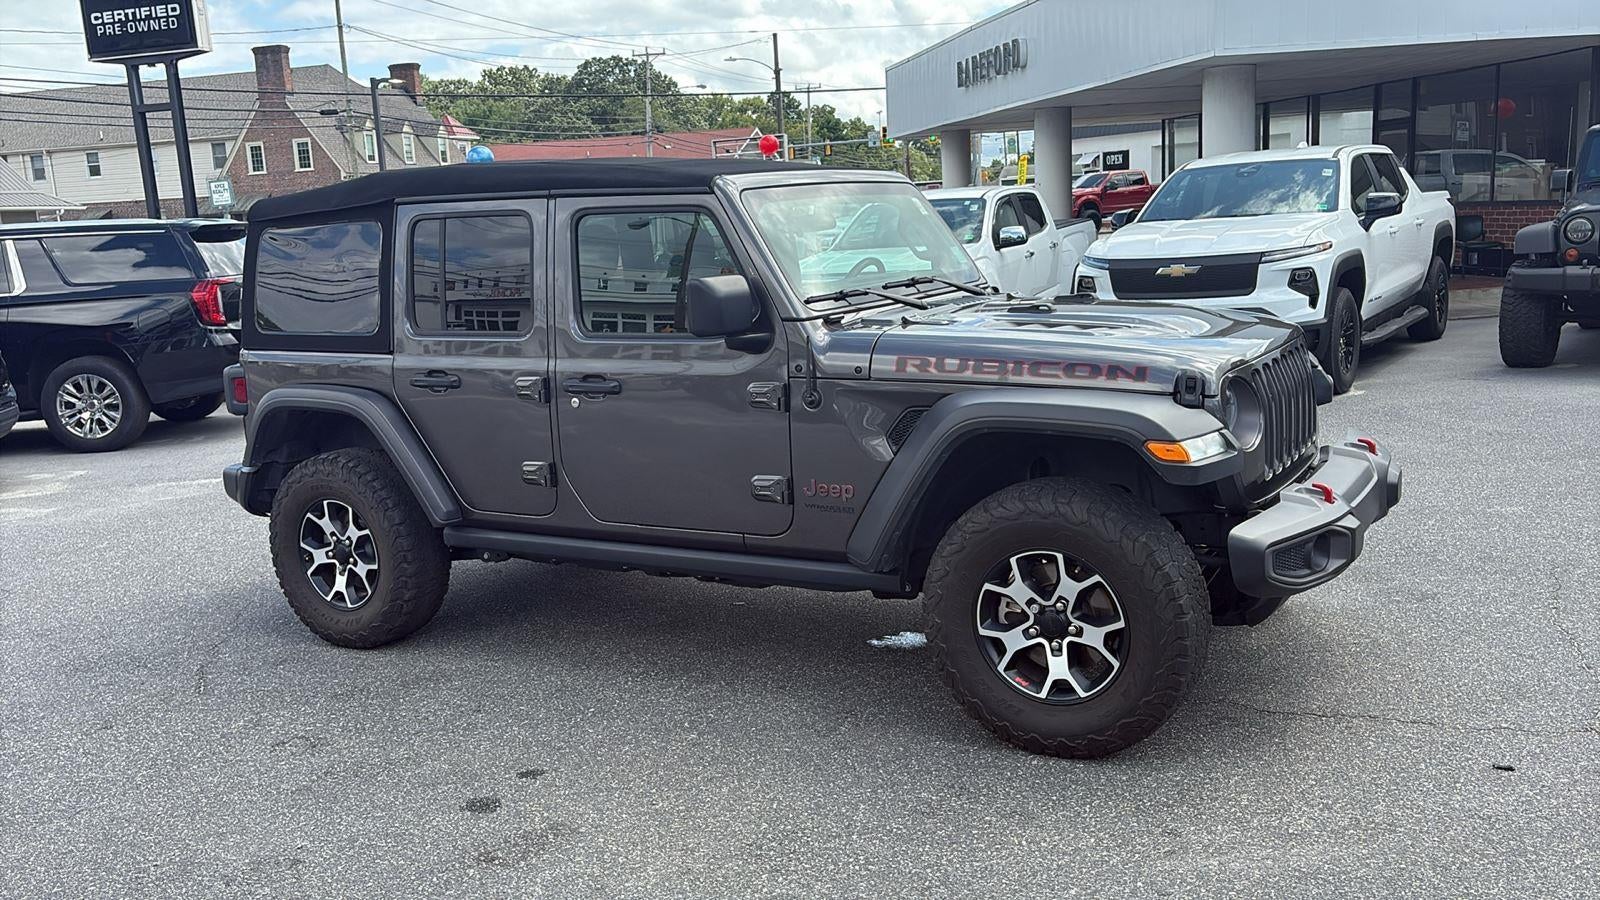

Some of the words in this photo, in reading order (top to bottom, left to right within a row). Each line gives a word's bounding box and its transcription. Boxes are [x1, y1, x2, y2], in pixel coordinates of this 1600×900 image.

[90, 3, 180, 24] CERTIFIED
[96, 17, 178, 36] PRE-OWNED
[956, 38, 1028, 88] BAREFORD
[1106, 154, 1123, 165] OPEN
[894, 356, 1149, 383] RUBICON
[803, 479, 855, 502] Jeep
